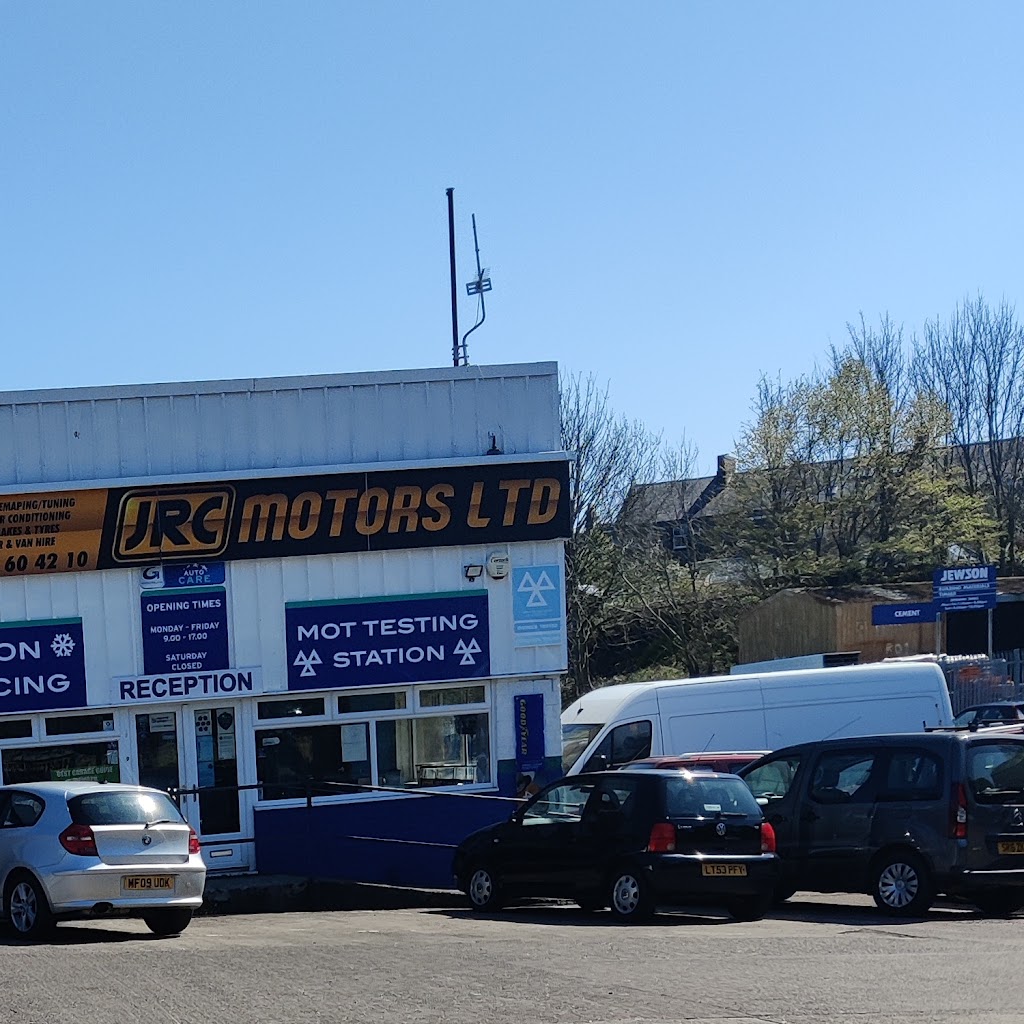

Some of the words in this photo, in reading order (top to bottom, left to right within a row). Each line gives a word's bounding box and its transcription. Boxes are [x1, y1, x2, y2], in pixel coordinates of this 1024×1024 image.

[8, 511, 71, 523] CONDITIONING
[124, 497, 225, 552] JRC
[237, 482, 455, 543] MOTORS
[466, 477, 561, 528] LTD
[24, 526, 32, 535] &
[34, 524, 60, 534] TYRES
[6, 539, 12, 548] &
[15, 538, 33, 548] VAN
[36, 537, 56, 547] HIRE
[4, 554, 27, 572] 60
[34, 553, 58, 570] 42
[67, 551, 88, 568] 10
[183, 569, 204, 577] AUTO
[940, 567, 988, 581] JEWSON
[179, 575, 211, 584] CARE
[146, 601, 189, 612] OPENING
[192, 599, 221, 609] TIMES
[894, 609, 921, 618] CEMENT
[150, 624, 184, 634] MONDAY
[191, 622, 220, 631] FRIDAY
[297, 622, 357, 641] MOT
[362, 614, 478, 637] TESTING
[163, 634, 181, 642] 9.00
[188, 633, 207, 641] 17.00
[166, 652, 207, 661] SATURDAY
[333, 645, 445, 668] STATION
[171, 662, 202, 671] CLOSED
[119, 672, 253, 700] RECEPTION
[520, 699, 529, 755] GOODYEAR
[705, 864, 726, 874] LT53
[728, 863, 742, 874] PFY
[128, 879, 151, 889] MF09
